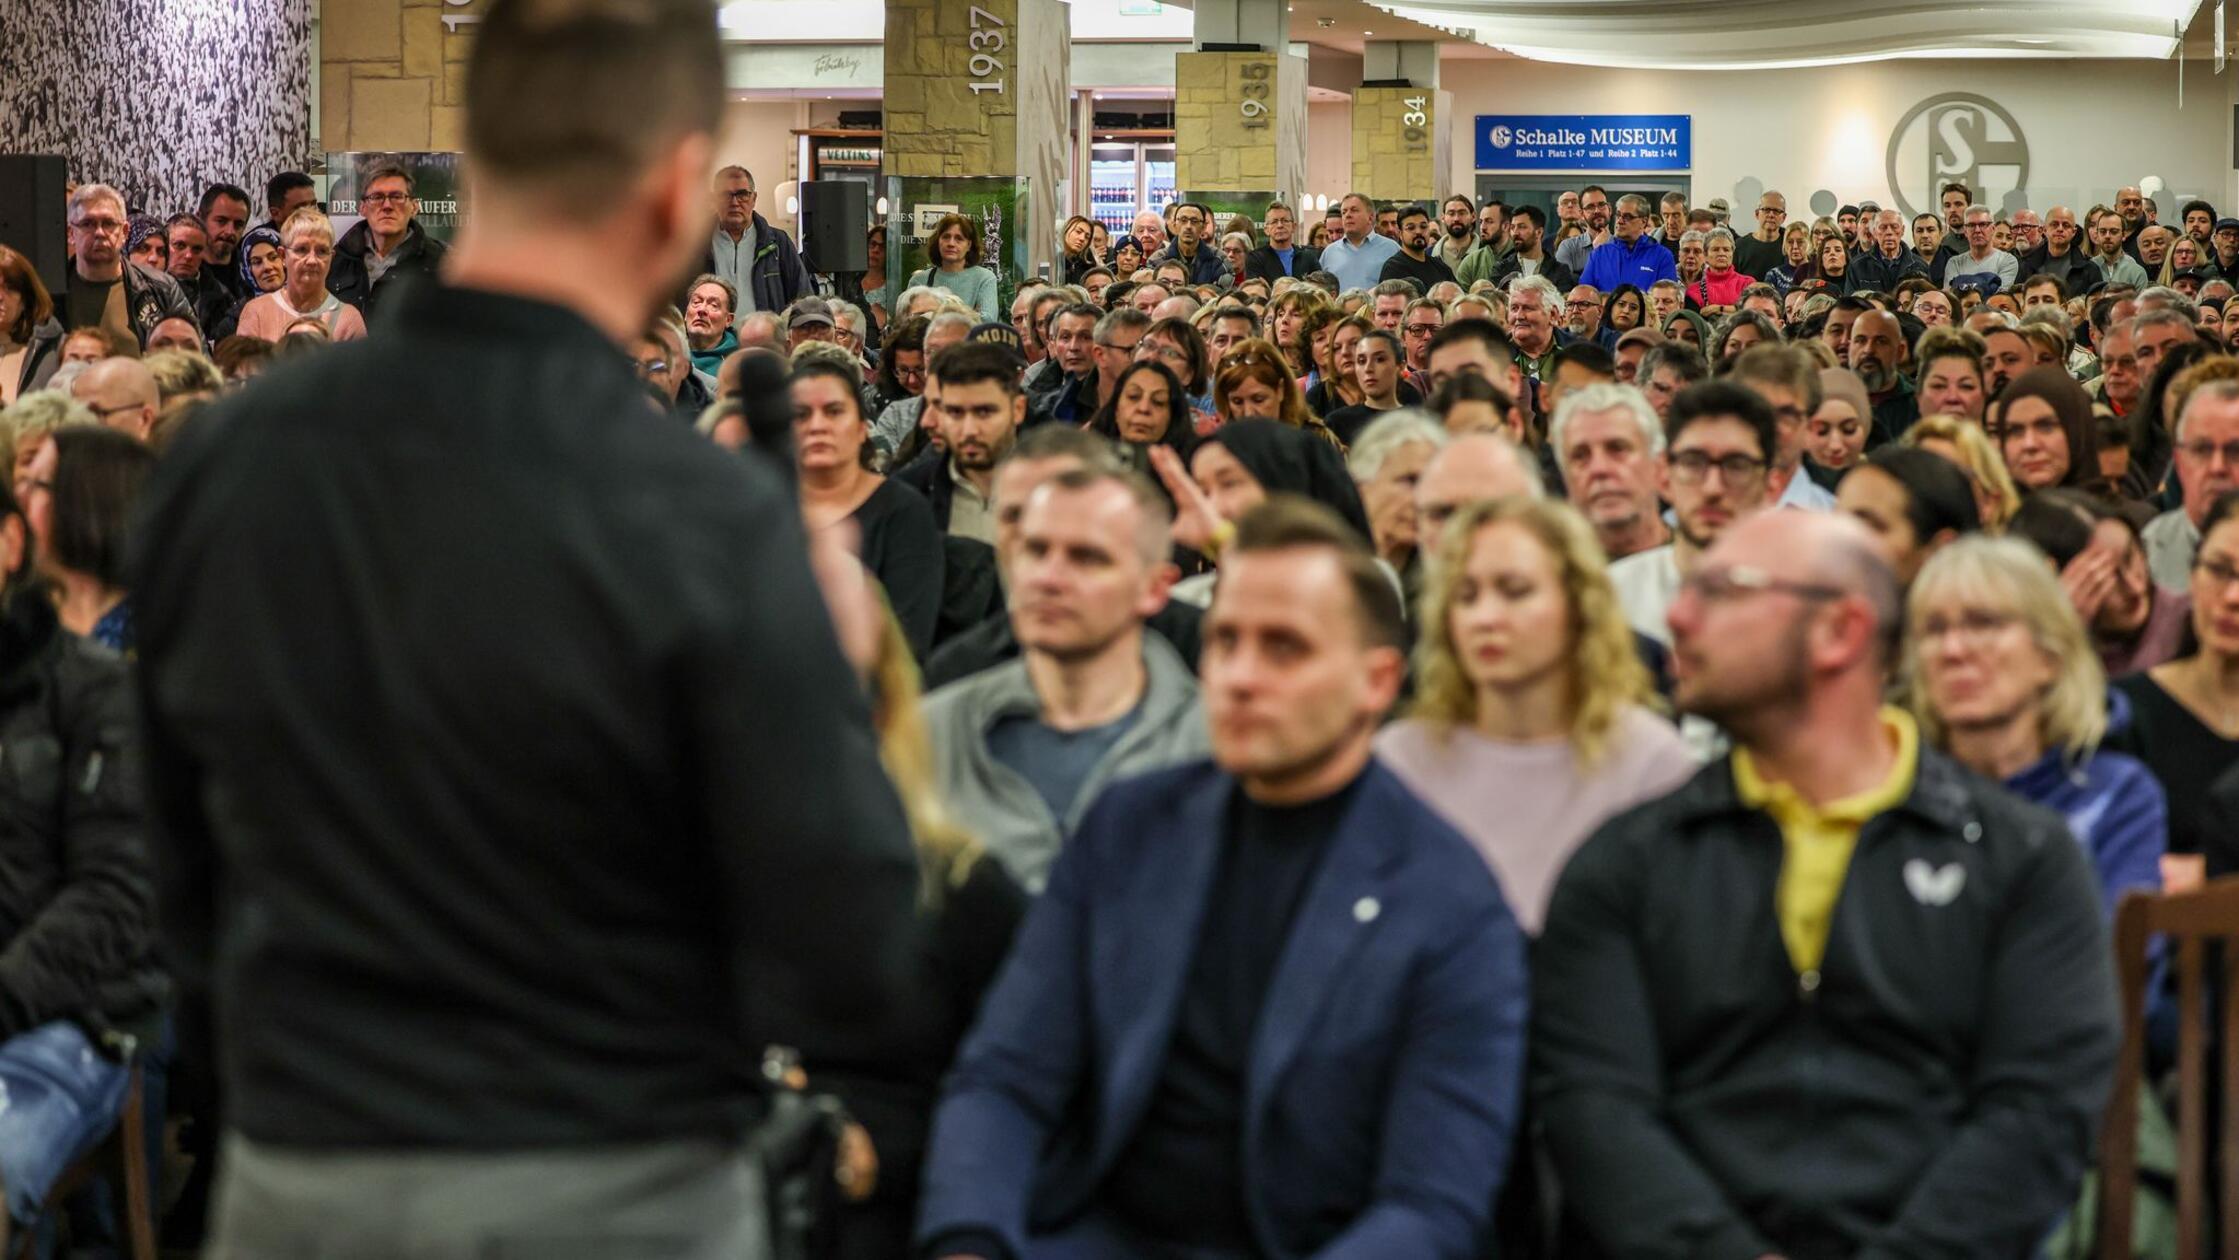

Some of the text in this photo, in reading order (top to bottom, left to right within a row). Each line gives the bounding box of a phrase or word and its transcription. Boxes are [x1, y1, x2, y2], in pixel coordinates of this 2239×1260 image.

[969, 6, 1004, 95] 1937
[1241, 63, 1270, 130] 1935
[1404, 96, 1427, 152] 1934
[1516, 128, 1678, 145] Schalke MUSEUM
[827, 150, 872, 160] VELTINS
[1516, 149, 1537, 158] Reihe
[1548, 149, 1566, 158] Platz
[1589, 149, 1604, 158] und
[1608, 149, 1630, 158] Reihe
[1631, 149, 1637, 158] 2
[1640, 149, 1659, 158] Platz
[332, 198, 457, 214] DER ÄUFER
[976, 328, 1018, 348] MOIN
